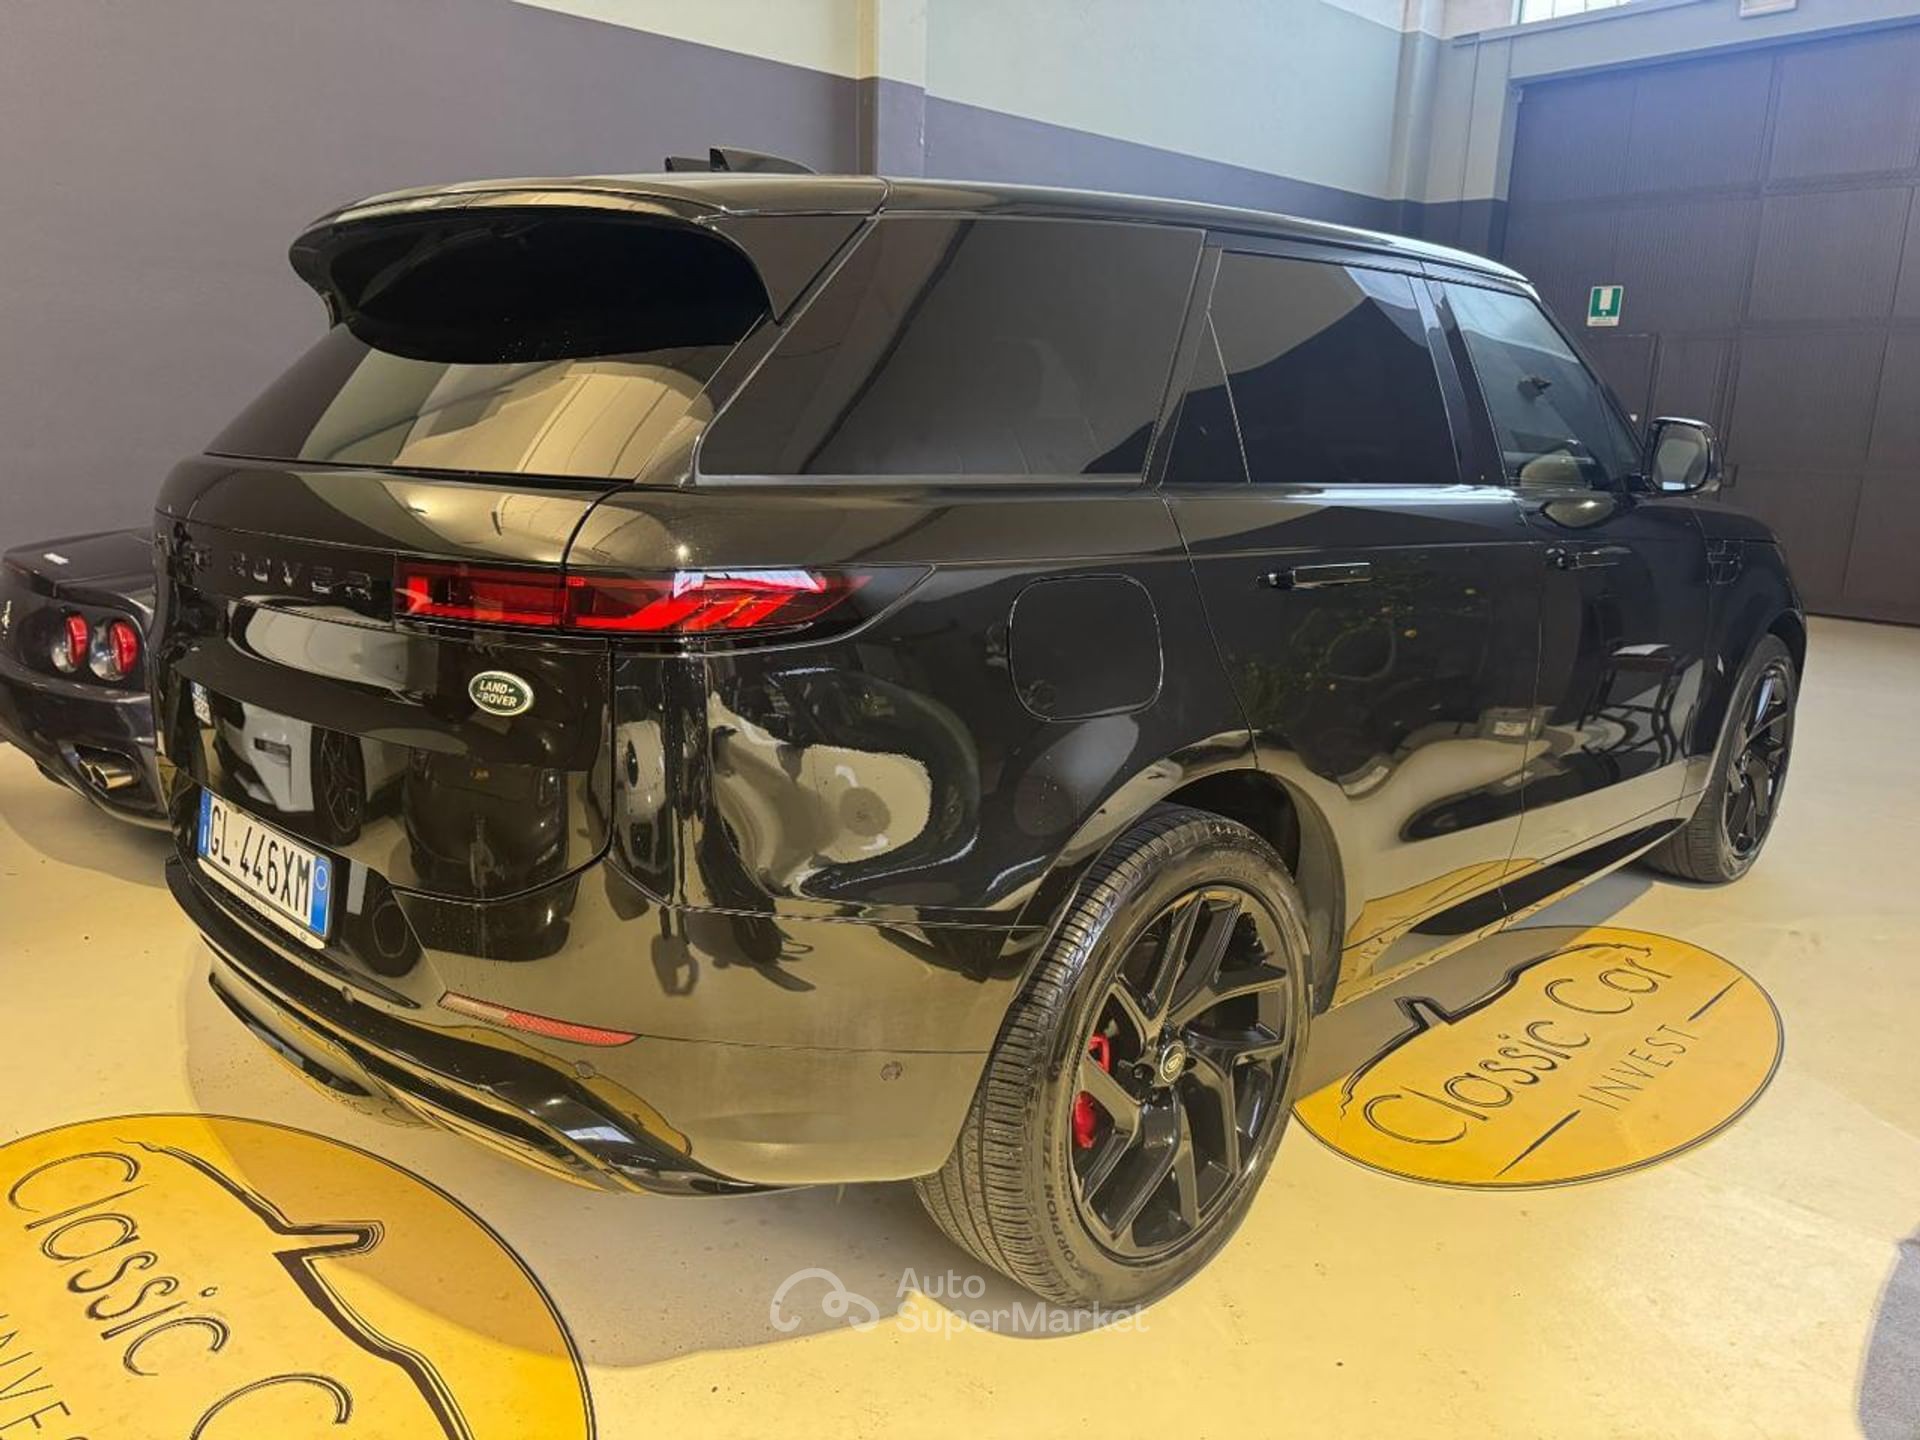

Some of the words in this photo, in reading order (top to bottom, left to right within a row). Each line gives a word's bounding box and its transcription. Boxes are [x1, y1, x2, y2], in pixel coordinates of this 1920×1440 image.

[240, 826, 310, 917] 446XM
[1363, 1020, 1590, 1145] Classic
[1544, 956, 1672, 1014] Car
[1578, 1023, 1699, 1111] INVEST
[8, 1151, 231, 1376] Classic
